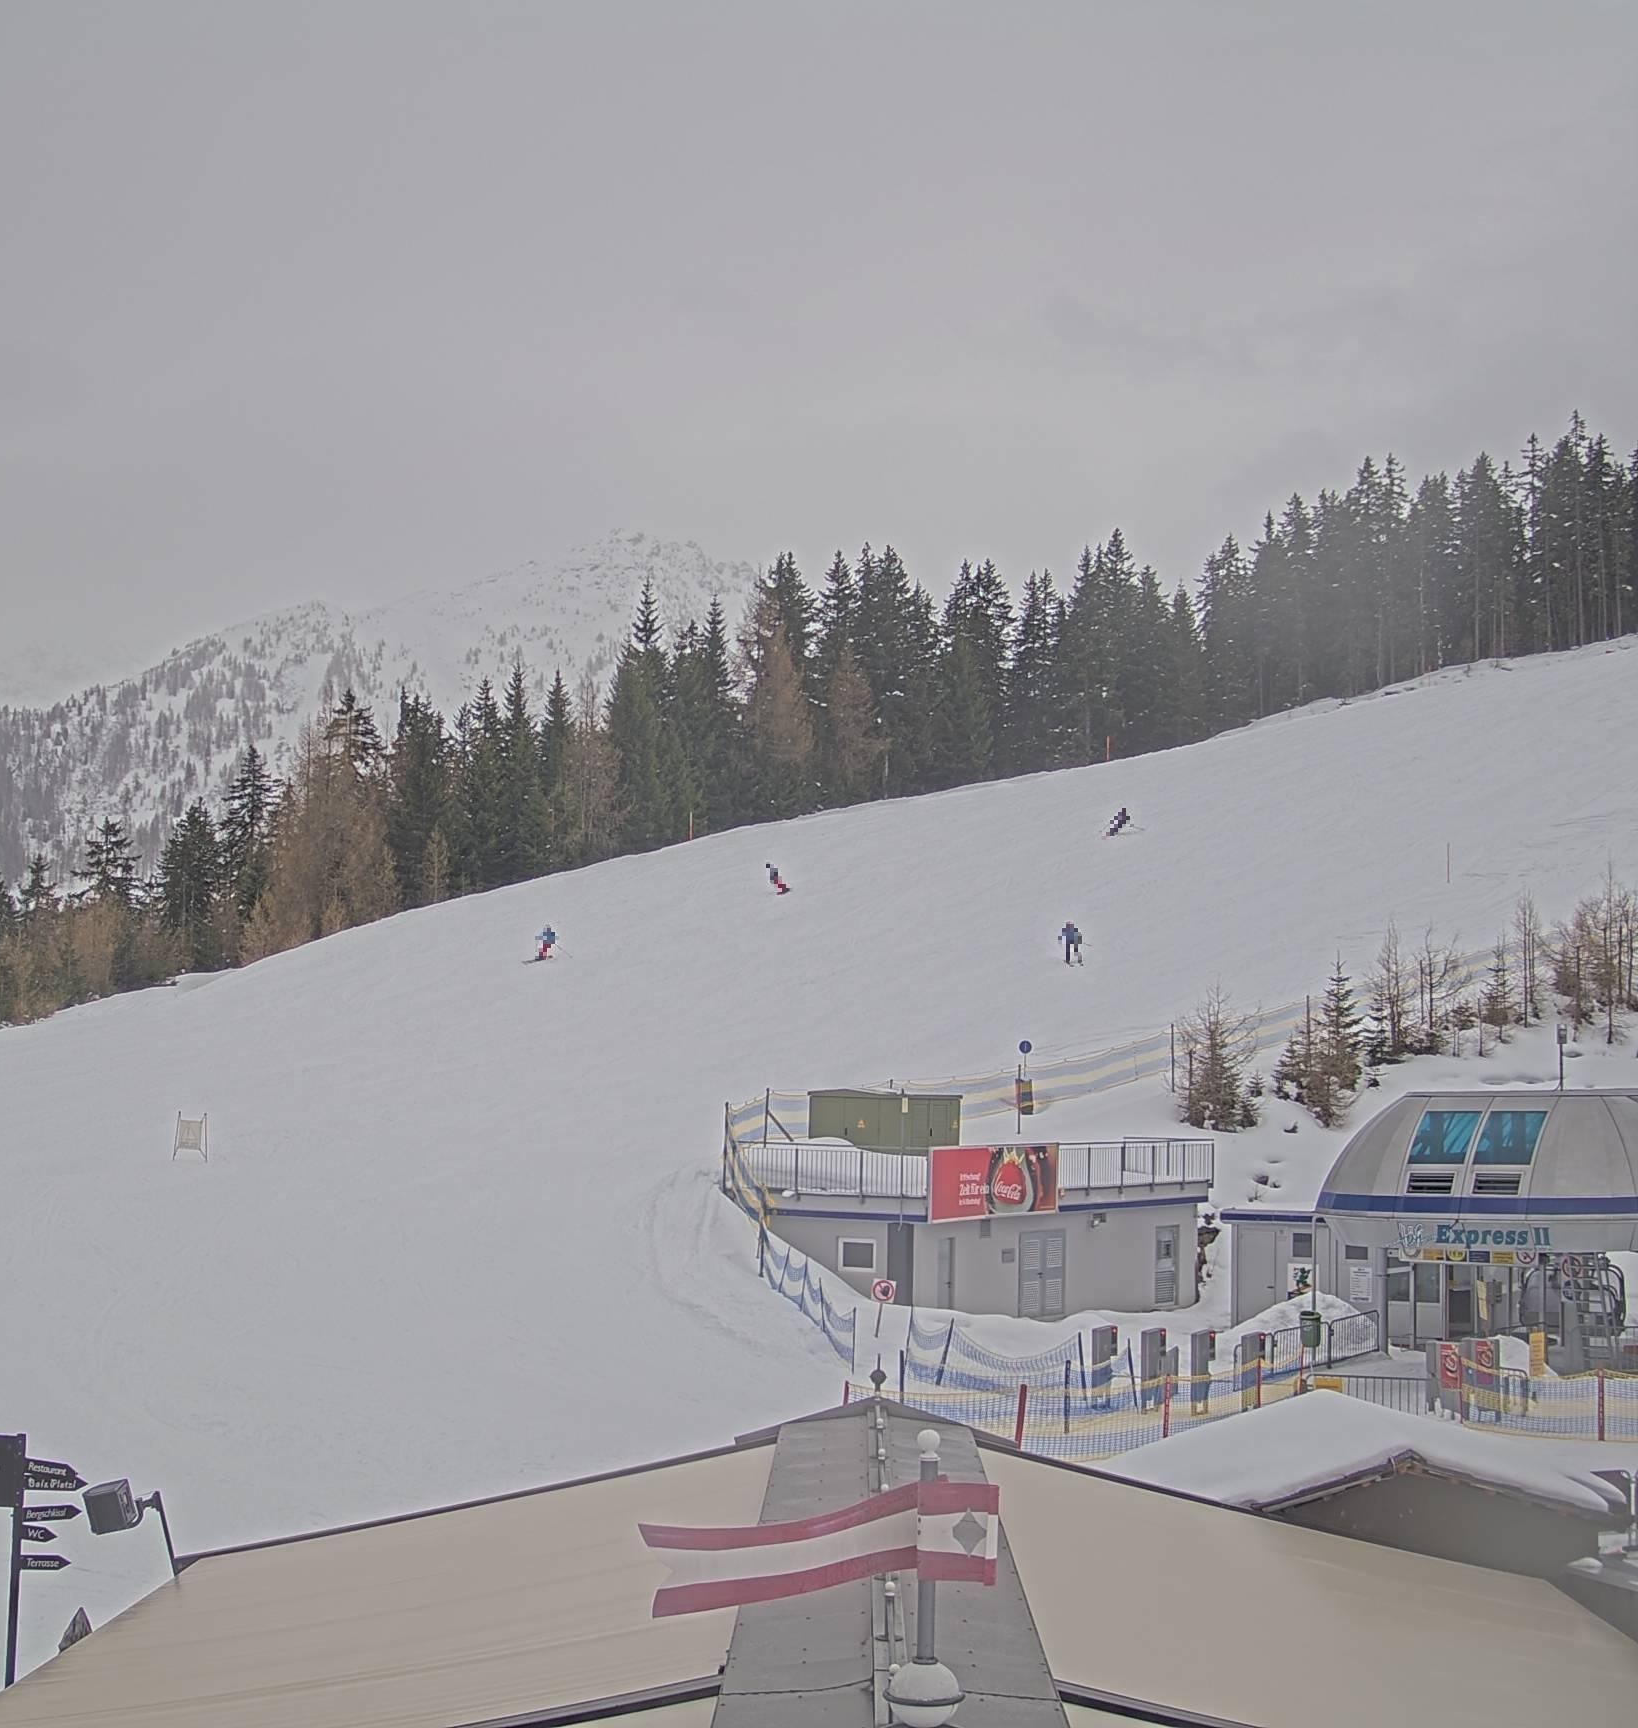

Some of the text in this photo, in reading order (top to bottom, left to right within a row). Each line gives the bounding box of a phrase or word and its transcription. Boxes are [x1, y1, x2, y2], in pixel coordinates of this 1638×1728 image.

[1436, 1224, 1529, 1249] Express
[28, 1461, 67, 1477] Restaurant
[27, 1528, 45, 1539] WC
[27, 1557, 60, 1568] Terrasse
